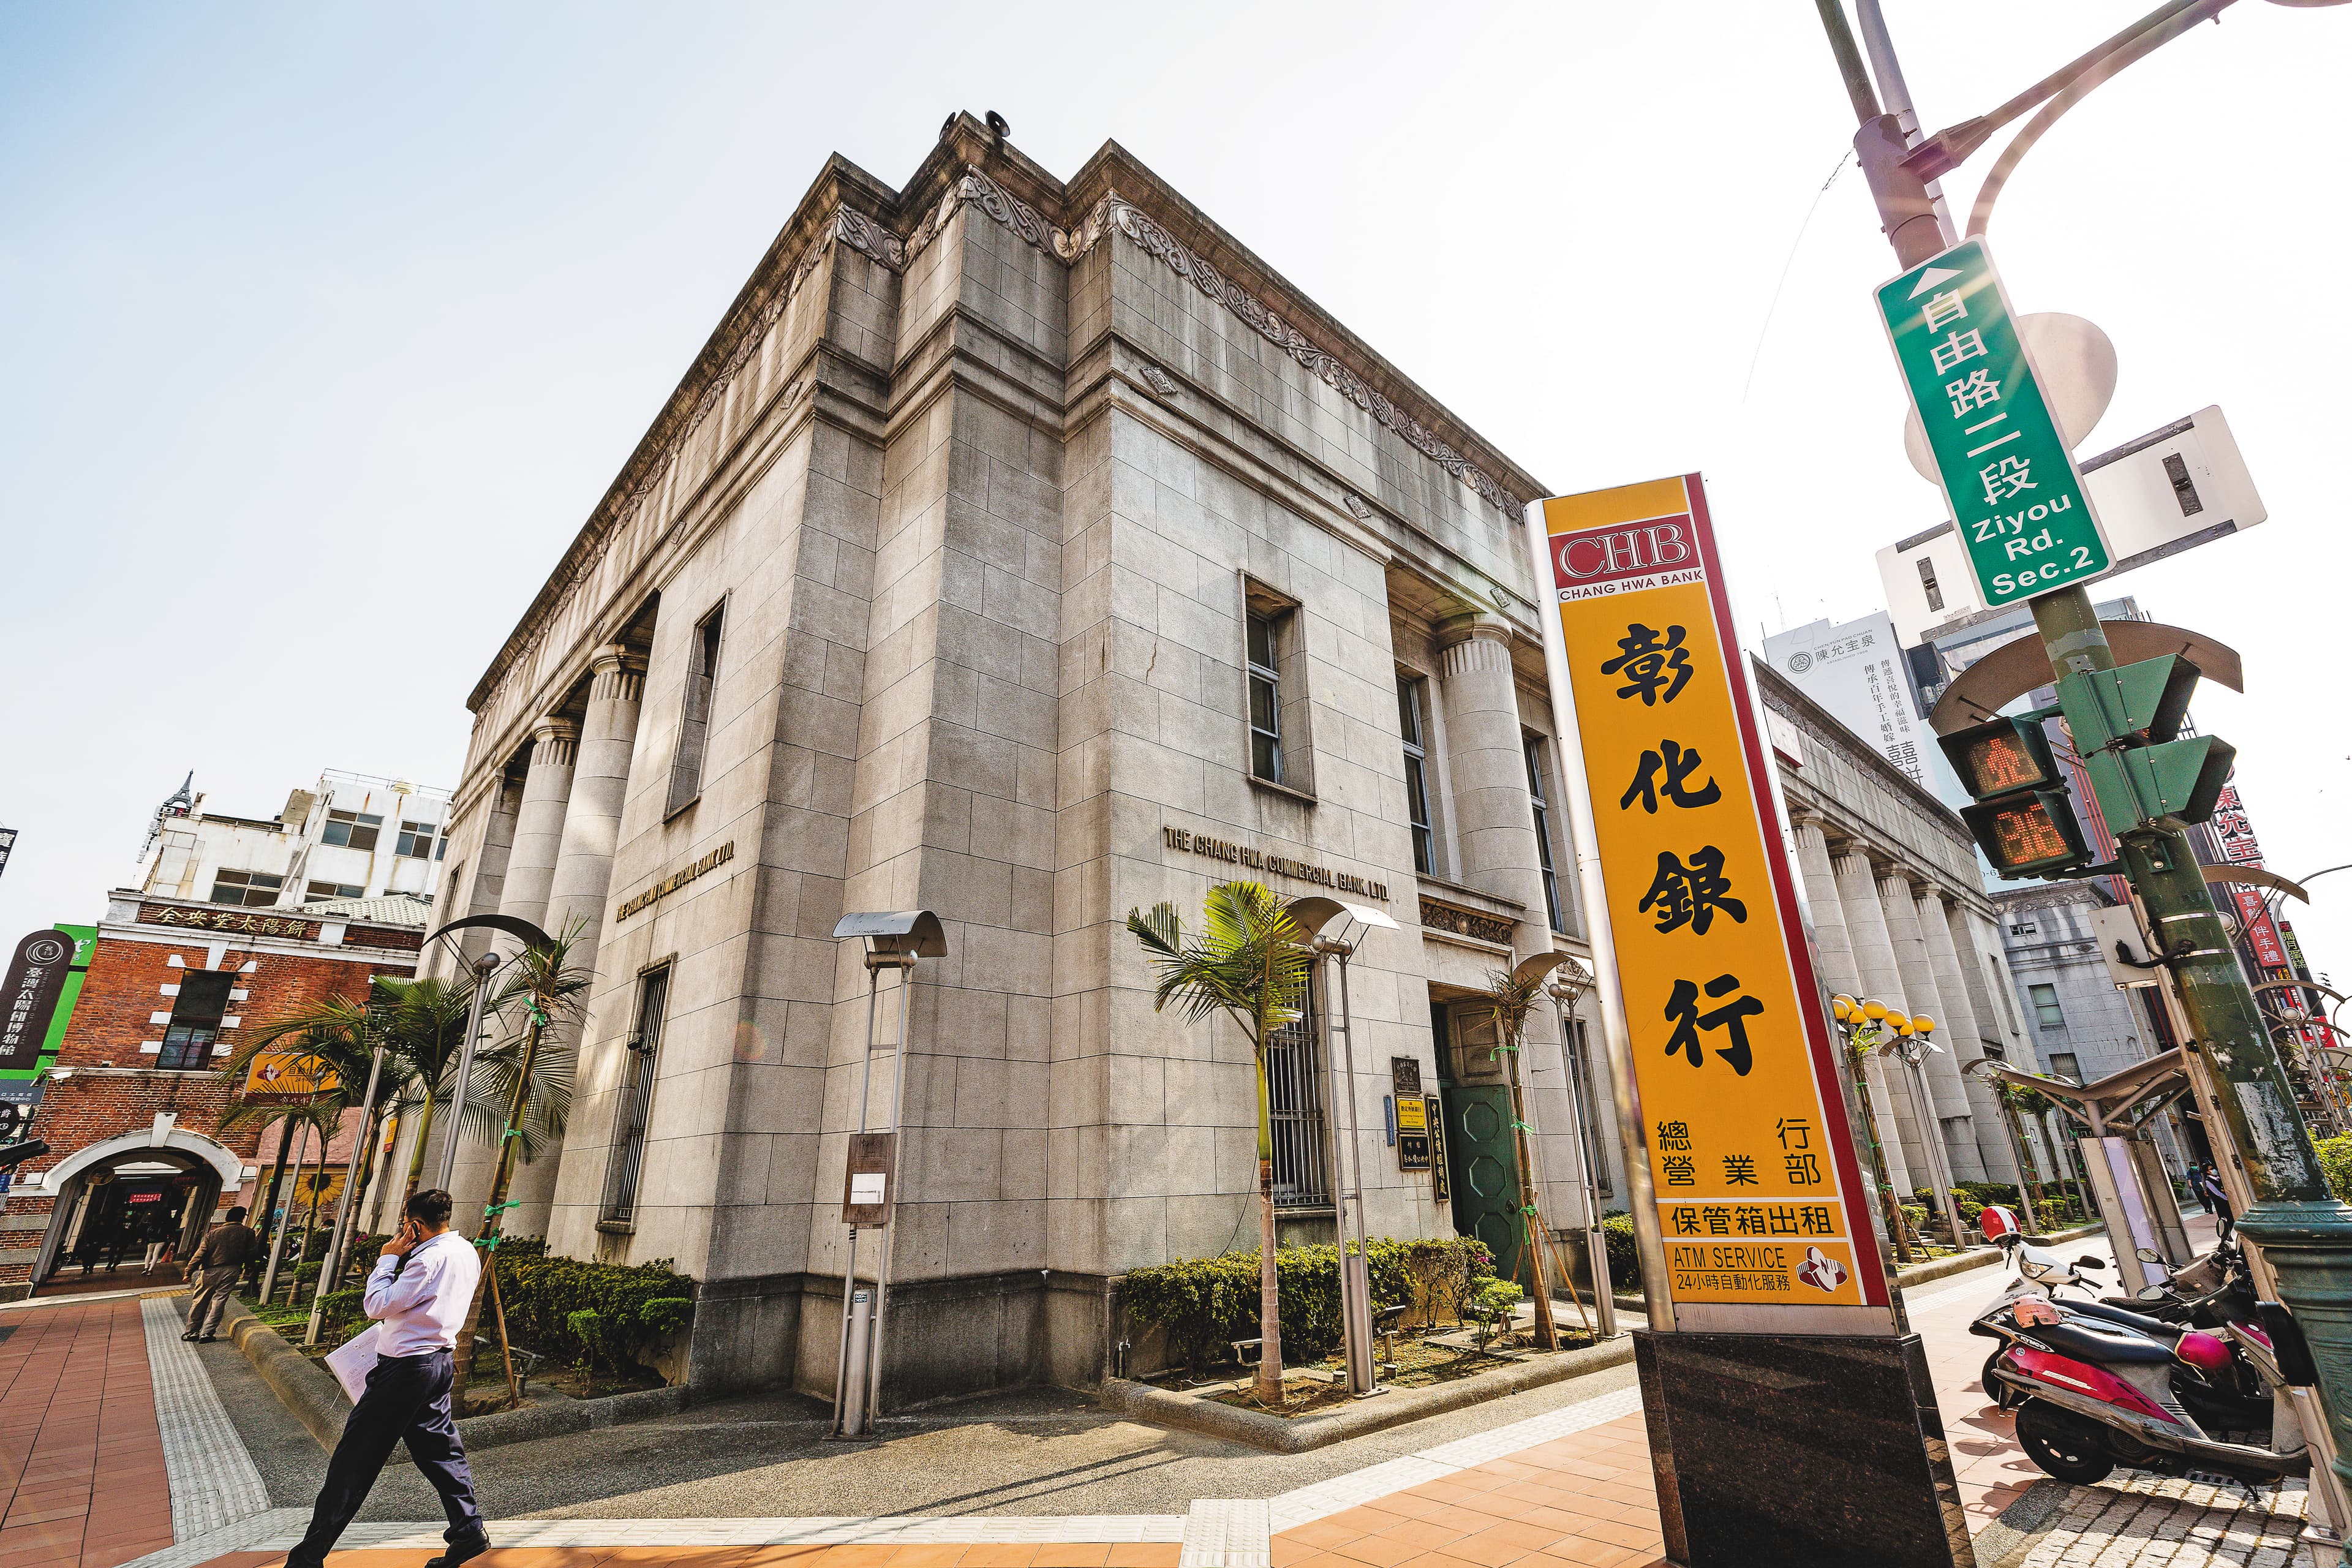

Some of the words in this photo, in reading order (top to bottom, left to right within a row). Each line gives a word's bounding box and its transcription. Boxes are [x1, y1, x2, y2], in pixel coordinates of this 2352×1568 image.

[1921, 288, 2038, 506] 自由路二段
[1972, 494, 2072, 543] Ziyou
[1559, 524, 1691, 578] CHB
[2005, 528, 2064, 562] Rd.
[1560, 584, 1616, 600] CHANG
[1621, 577, 1654, 592] HWA
[1661, 570, 1704, 585] BANK
[1992, 546, 2094, 595] Sec.2
[1815, 635, 1875, 662] 陳允宝泉
[1853, 629, 1872, 638] CHUAN
[1864, 663, 1895, 743] 傳承百年手工婚嫁
[1881, 659, 1910, 733] 傳遞喜悅的幸福滋味
[1164, 826, 1191, 851] THE
[1194, 834, 1238, 863] CHANG
[1240, 846, 1265, 870] HWA
[1267, 854, 1337, 888] COMMERCIAL
[1601, 623, 1765, 1077] 彰化銀行
[616, 903, 627, 923] THE
[626, 892, 647, 916] CHANG
[646, 884, 659, 906] HWA
[657, 862, 697, 899] COMMERCIAL
[156, 907, 307, 938] 全安堂太陽餅
[0, 967, 44, 1055] 臺灣太陽餅博物館
[1657, 1117, 1811, 1152] 總行
[1662, 1153, 1822, 1186] 營業部
[1671, 1205, 1834, 1235] 保管箱出租
[1674, 1247, 1706, 1268] ATM
[1714, 1247, 1787, 1268] SERVICE
[1677, 1273, 1790, 1292] 24小時自動化服務
[2020, 1335, 2046, 1350] KYMCO
